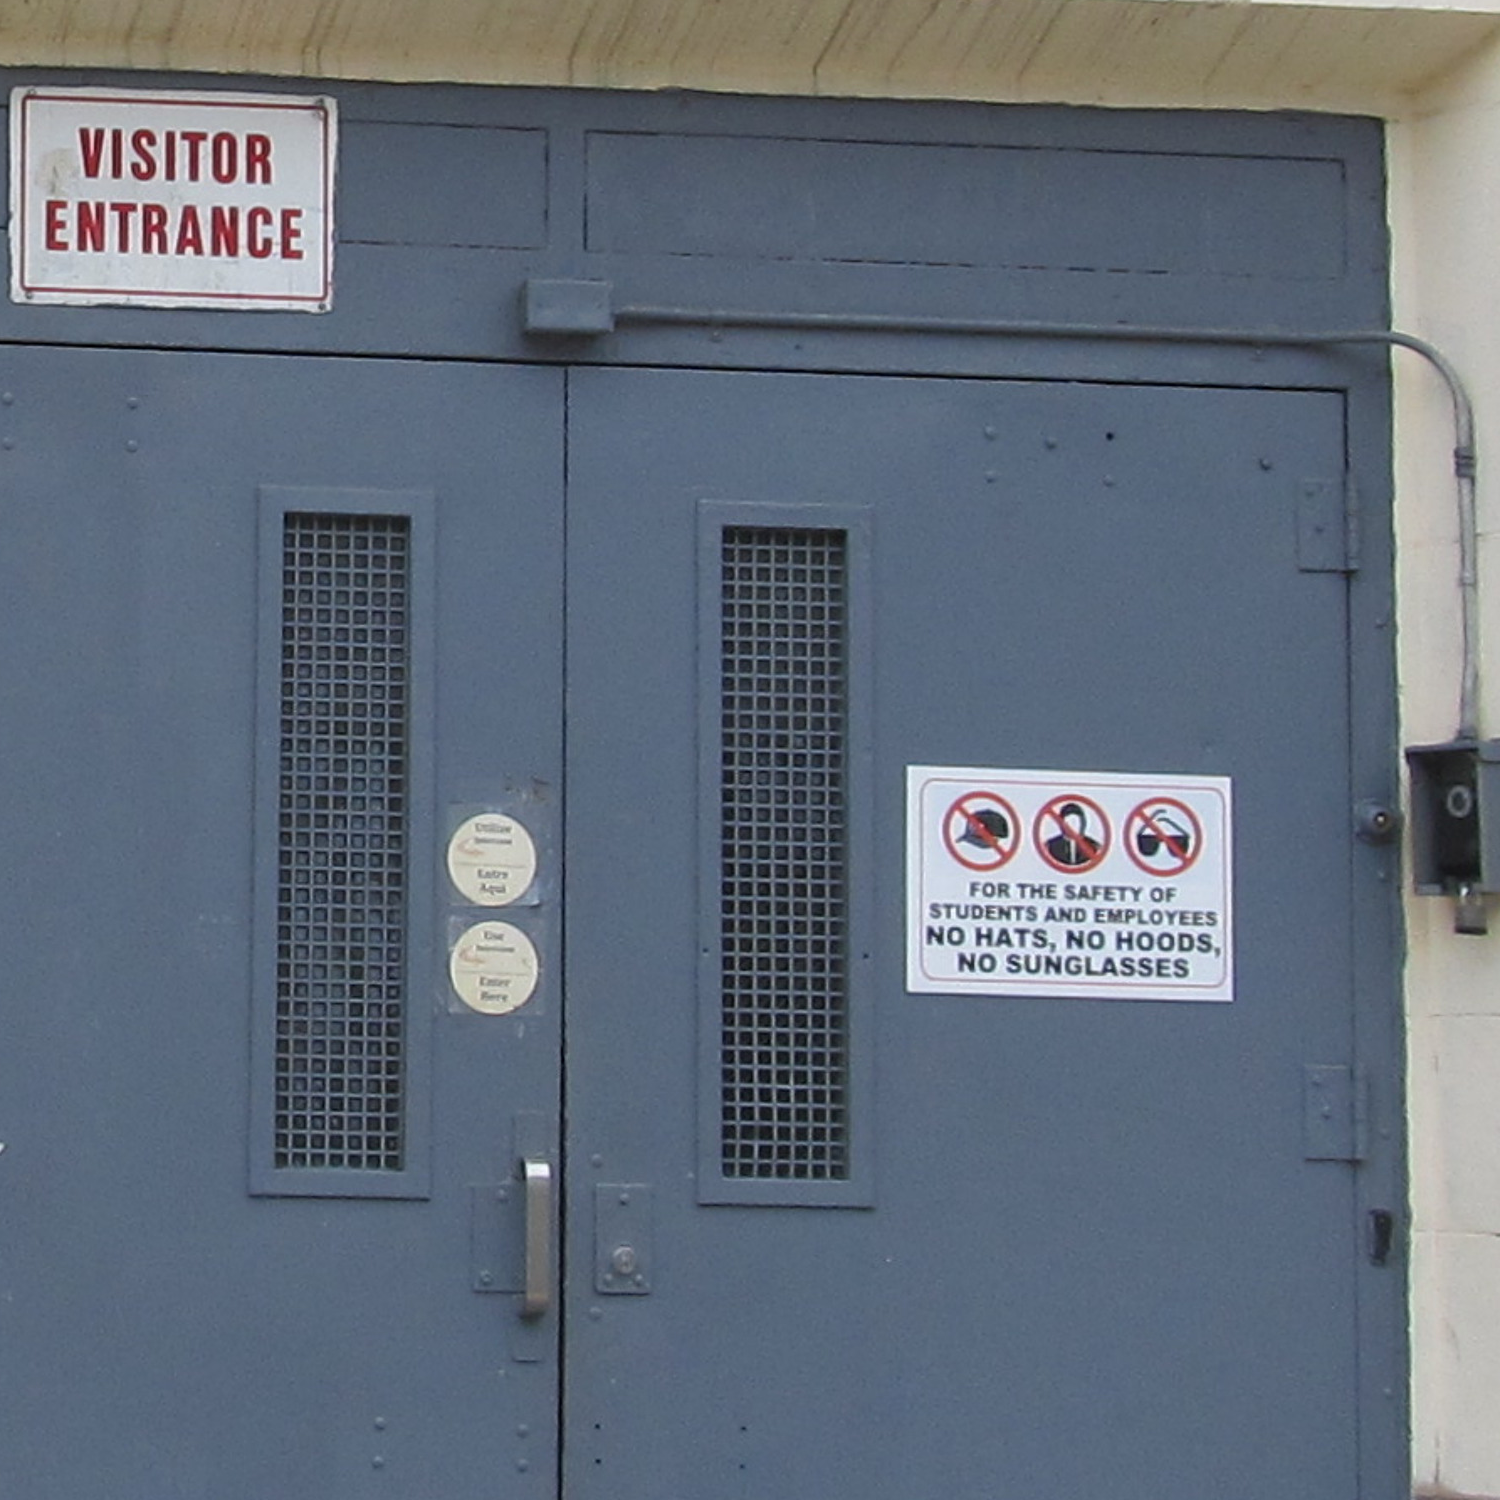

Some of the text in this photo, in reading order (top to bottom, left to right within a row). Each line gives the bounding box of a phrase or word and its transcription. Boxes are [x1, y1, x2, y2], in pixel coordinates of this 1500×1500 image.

[78, 127, 273, 185] VISITOR
[44, 199, 305, 261] ENTRANCE
[968, 881, 1178, 903] FOR THE SAFETY OF
[929, 903, 1219, 927] STUDENTS AND EMPLOYEES
[925, 925, 1221, 958] NO HATS, NO HOODS,
[957, 952, 1191, 979] NO SUNGLASSES
